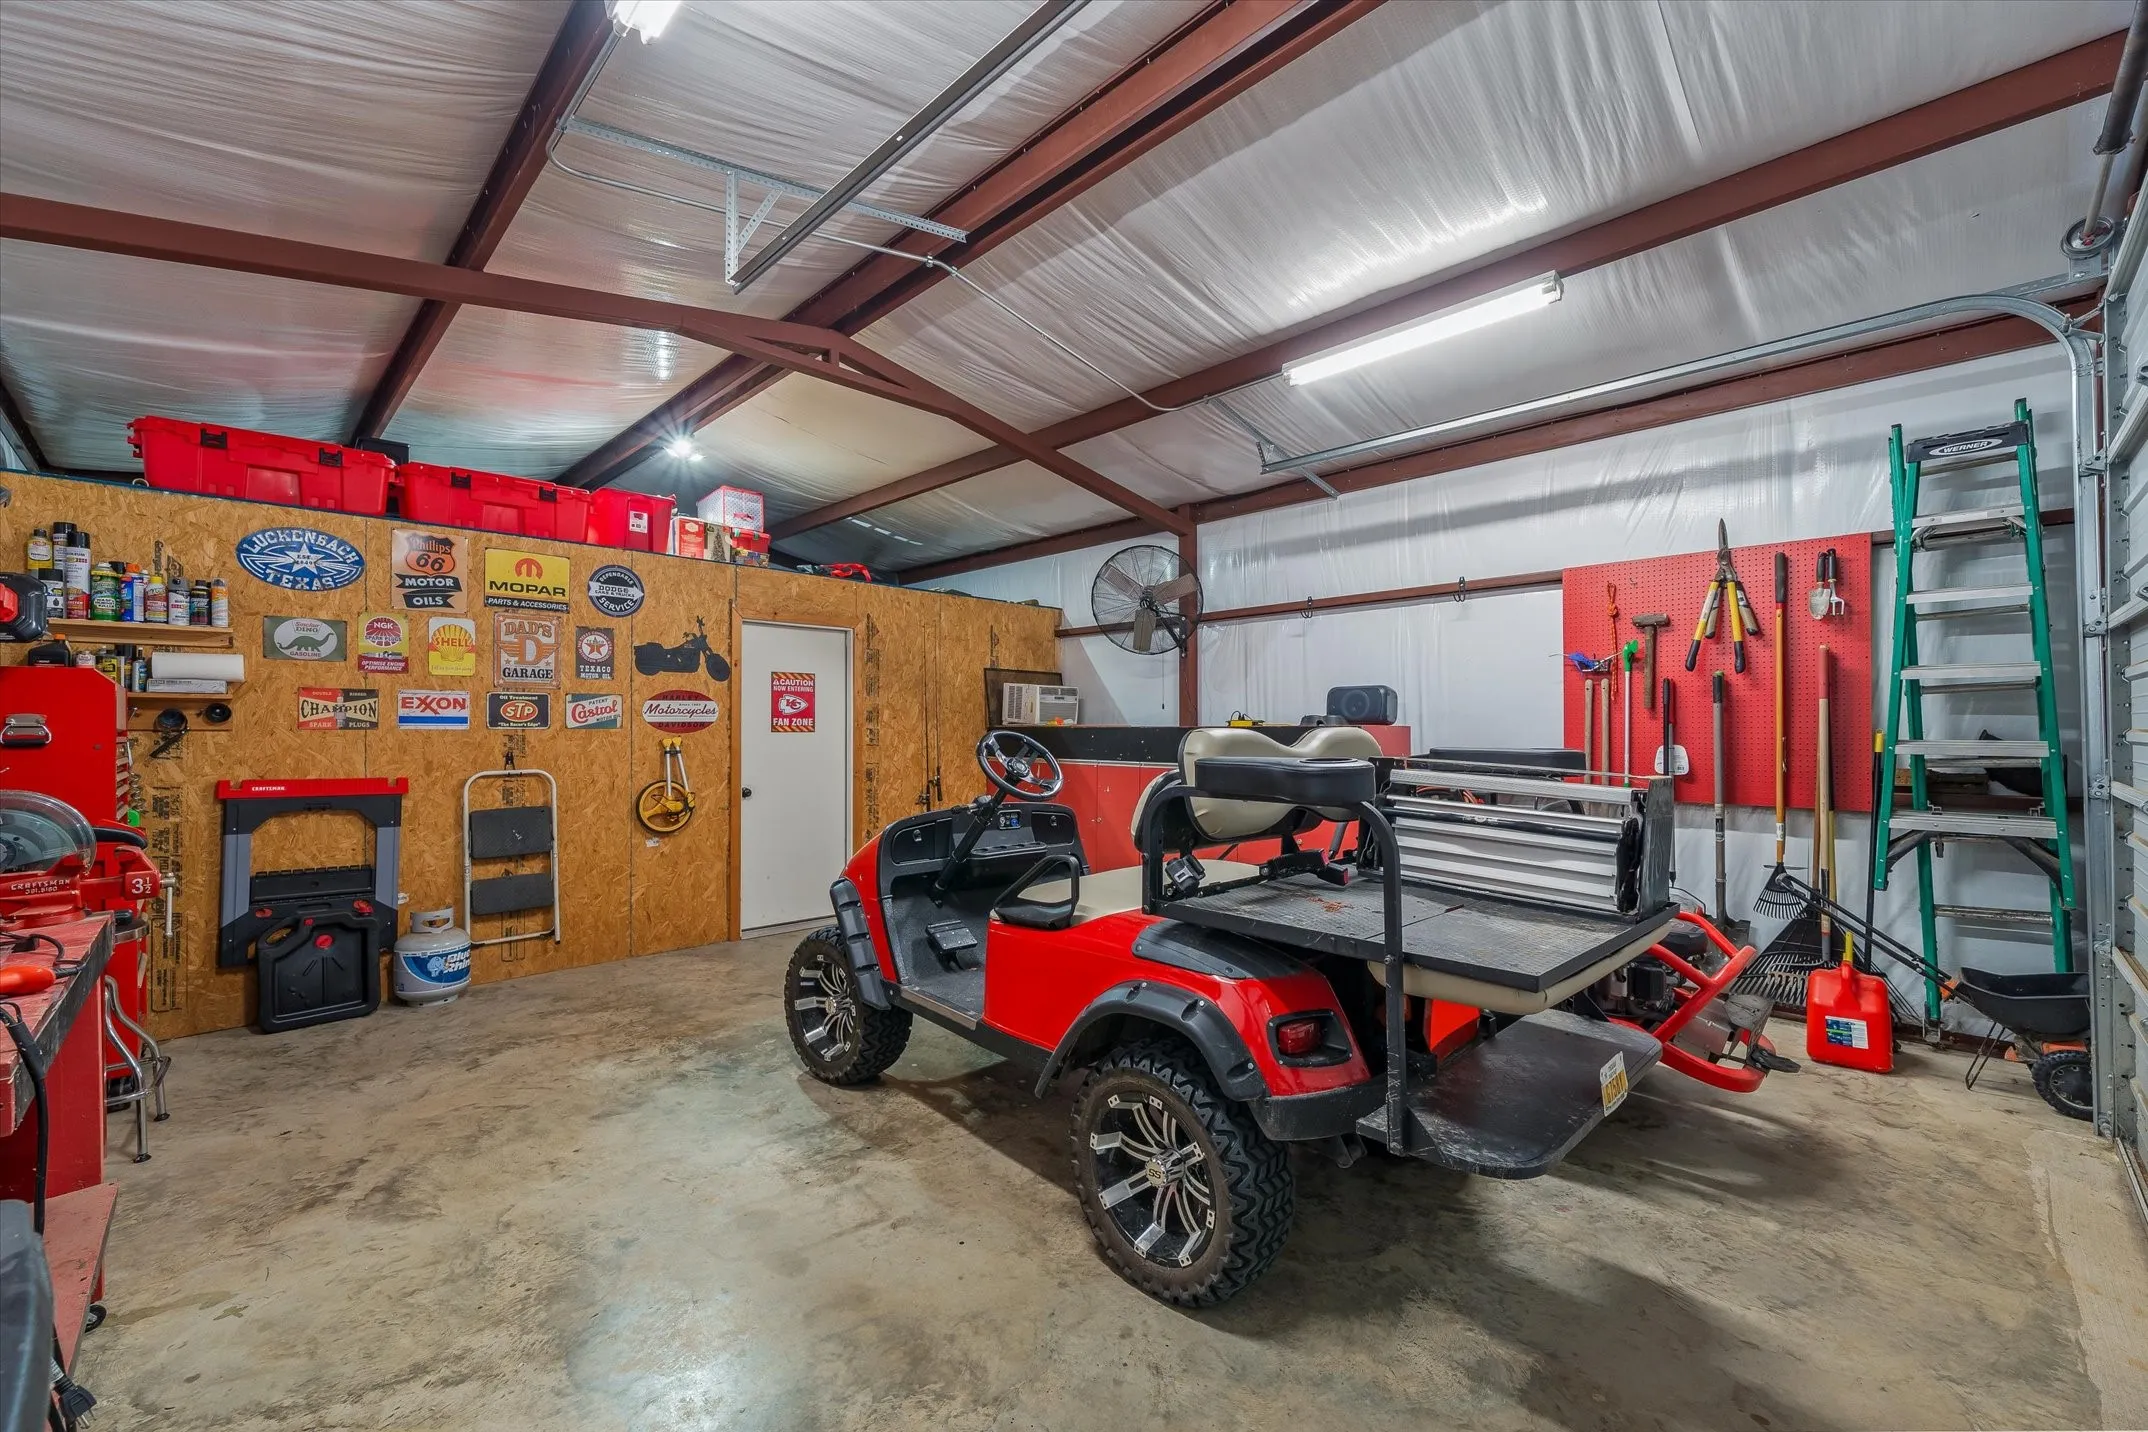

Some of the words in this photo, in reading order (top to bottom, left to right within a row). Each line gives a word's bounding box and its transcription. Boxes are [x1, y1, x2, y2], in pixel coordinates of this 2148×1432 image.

[1943, 441, 1988, 453] WERNER
[242, 529, 360, 563] LUCKENBACH
[410, 537, 451, 555] Phillips
[416, 553, 446, 571] 66
[265, 569, 335, 591] TEXAS
[405, 578, 454, 586] MOTOR
[599, 571, 634, 585] DEPENDABLE
[489, 580, 566, 597] MOPAR
[598, 585, 629, 594] DODGE
[412, 596, 444, 605] OILS
[488, 597, 512, 606] PARTS
[520, 600, 567, 611] ACCESSORIES
[599, 597, 634, 611] SERVICE
[373, 621, 394, 629] NGK
[504, 620, 553, 638] DAD'S
[434, 636, 470, 647] SHELL
[502, 667, 554, 679] GARAGE
[579, 665, 611, 673] TEXACO
[780, 679, 814, 687] CAUTION
[300, 699, 377, 719] CHAMPION
[401, 695, 467, 715] EXXON
[505, 702, 534, 718] STP
[571, 699, 618, 724] Castrol
[644, 703, 718, 719] Motorcycles
[773, 718, 789, 726] FAN
[791, 718, 814, 726] ZONE
[11, 879, 70, 891] CRAFTSMAN
[446, 949, 471, 963] Blue
[443, 958, 471, 974] Rhin
[1148, 1168, 1162, 1179] SS
